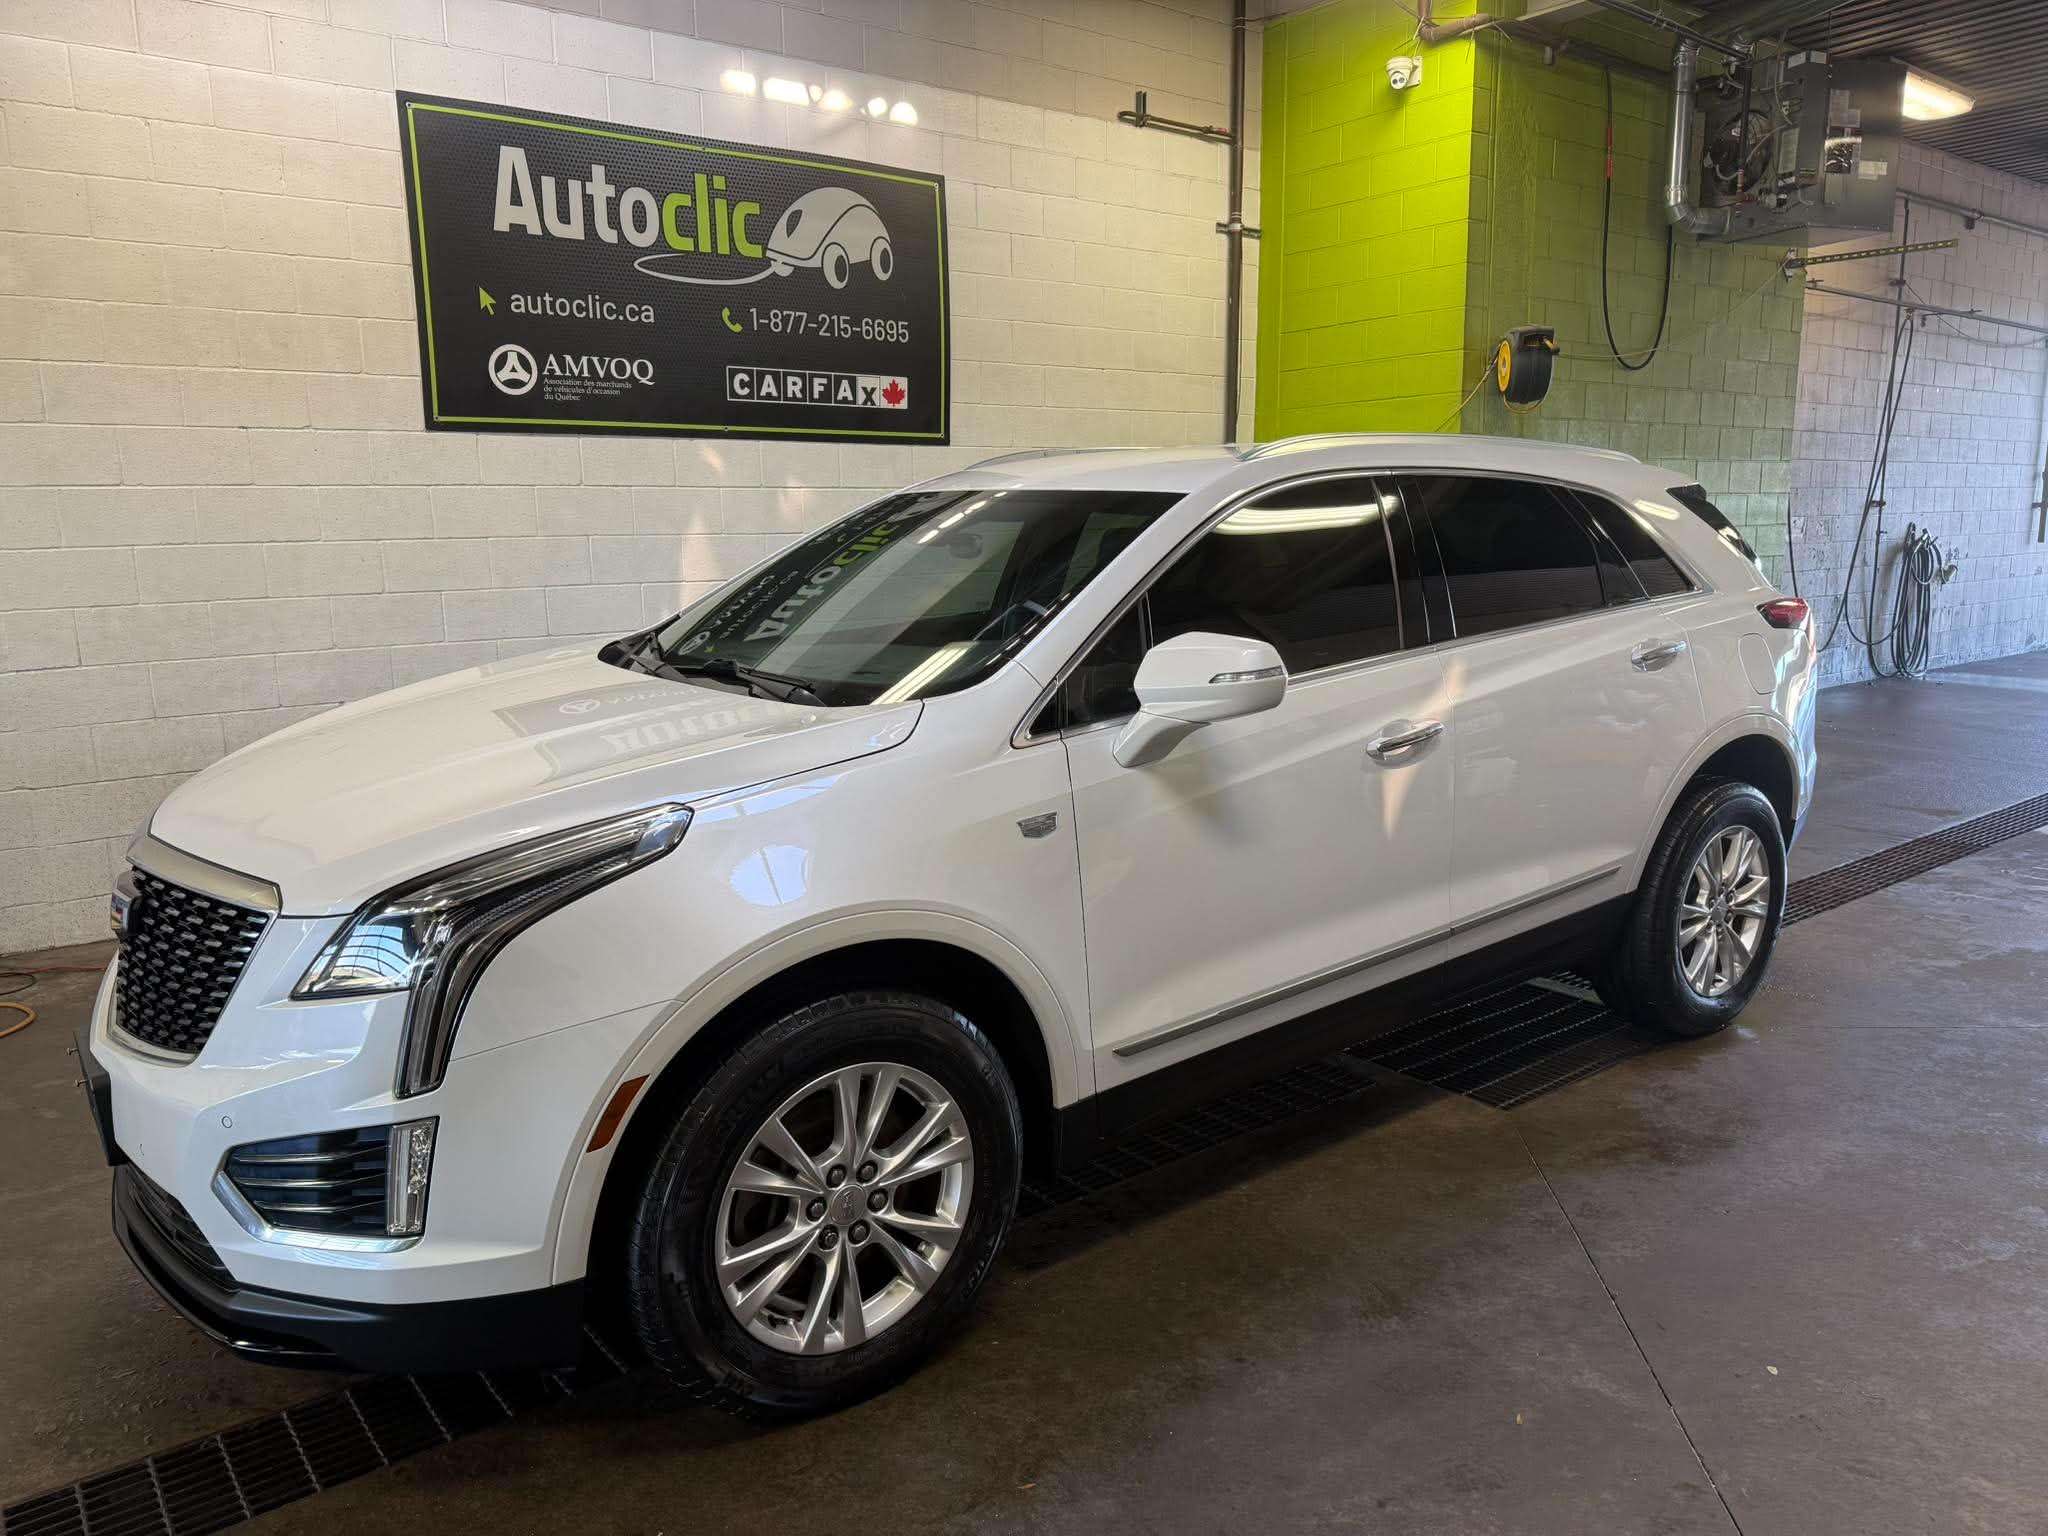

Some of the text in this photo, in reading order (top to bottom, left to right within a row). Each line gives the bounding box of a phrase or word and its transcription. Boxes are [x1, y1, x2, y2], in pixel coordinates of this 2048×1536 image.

[493, 145, 763, 258] Autoclic
[510, 292, 655, 323] autoclic.ca
[750, 307, 909, 343] 1-877-215-6695
[542, 353, 656, 386] AMVOQ
[544, 377, 632, 389] Association des marchands
[555, 393, 581, 401] Québec
[733, 372, 877, 406] CARFAX
